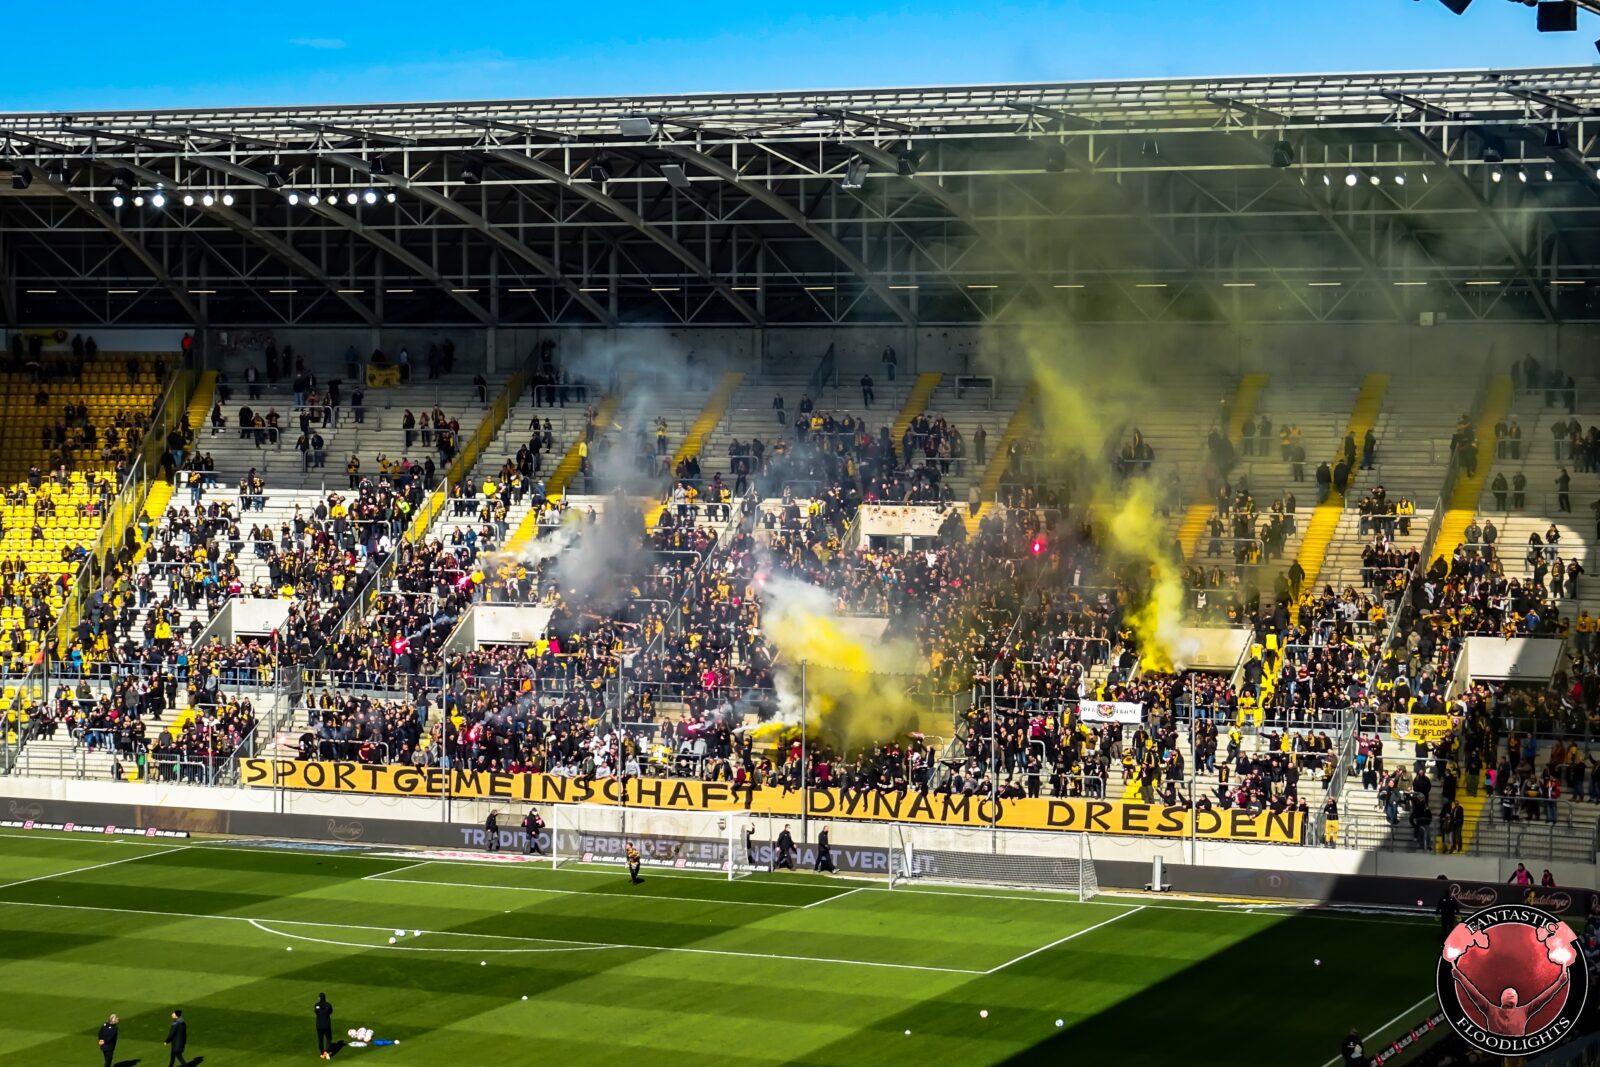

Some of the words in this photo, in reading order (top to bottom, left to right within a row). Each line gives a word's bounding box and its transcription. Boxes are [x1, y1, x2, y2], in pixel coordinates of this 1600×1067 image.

[1413, 718, 1448, 727] FANCLUB
[245, 758, 762, 810] SPORTGEMEINSCHAFT
[808, 788, 1003, 823] DYNAMO
[1048, 801, 1295, 839] DRESDEN
[461, 828, 565, 850] TRDITON
[686, 841, 842, 867] LEIDENSHAT
